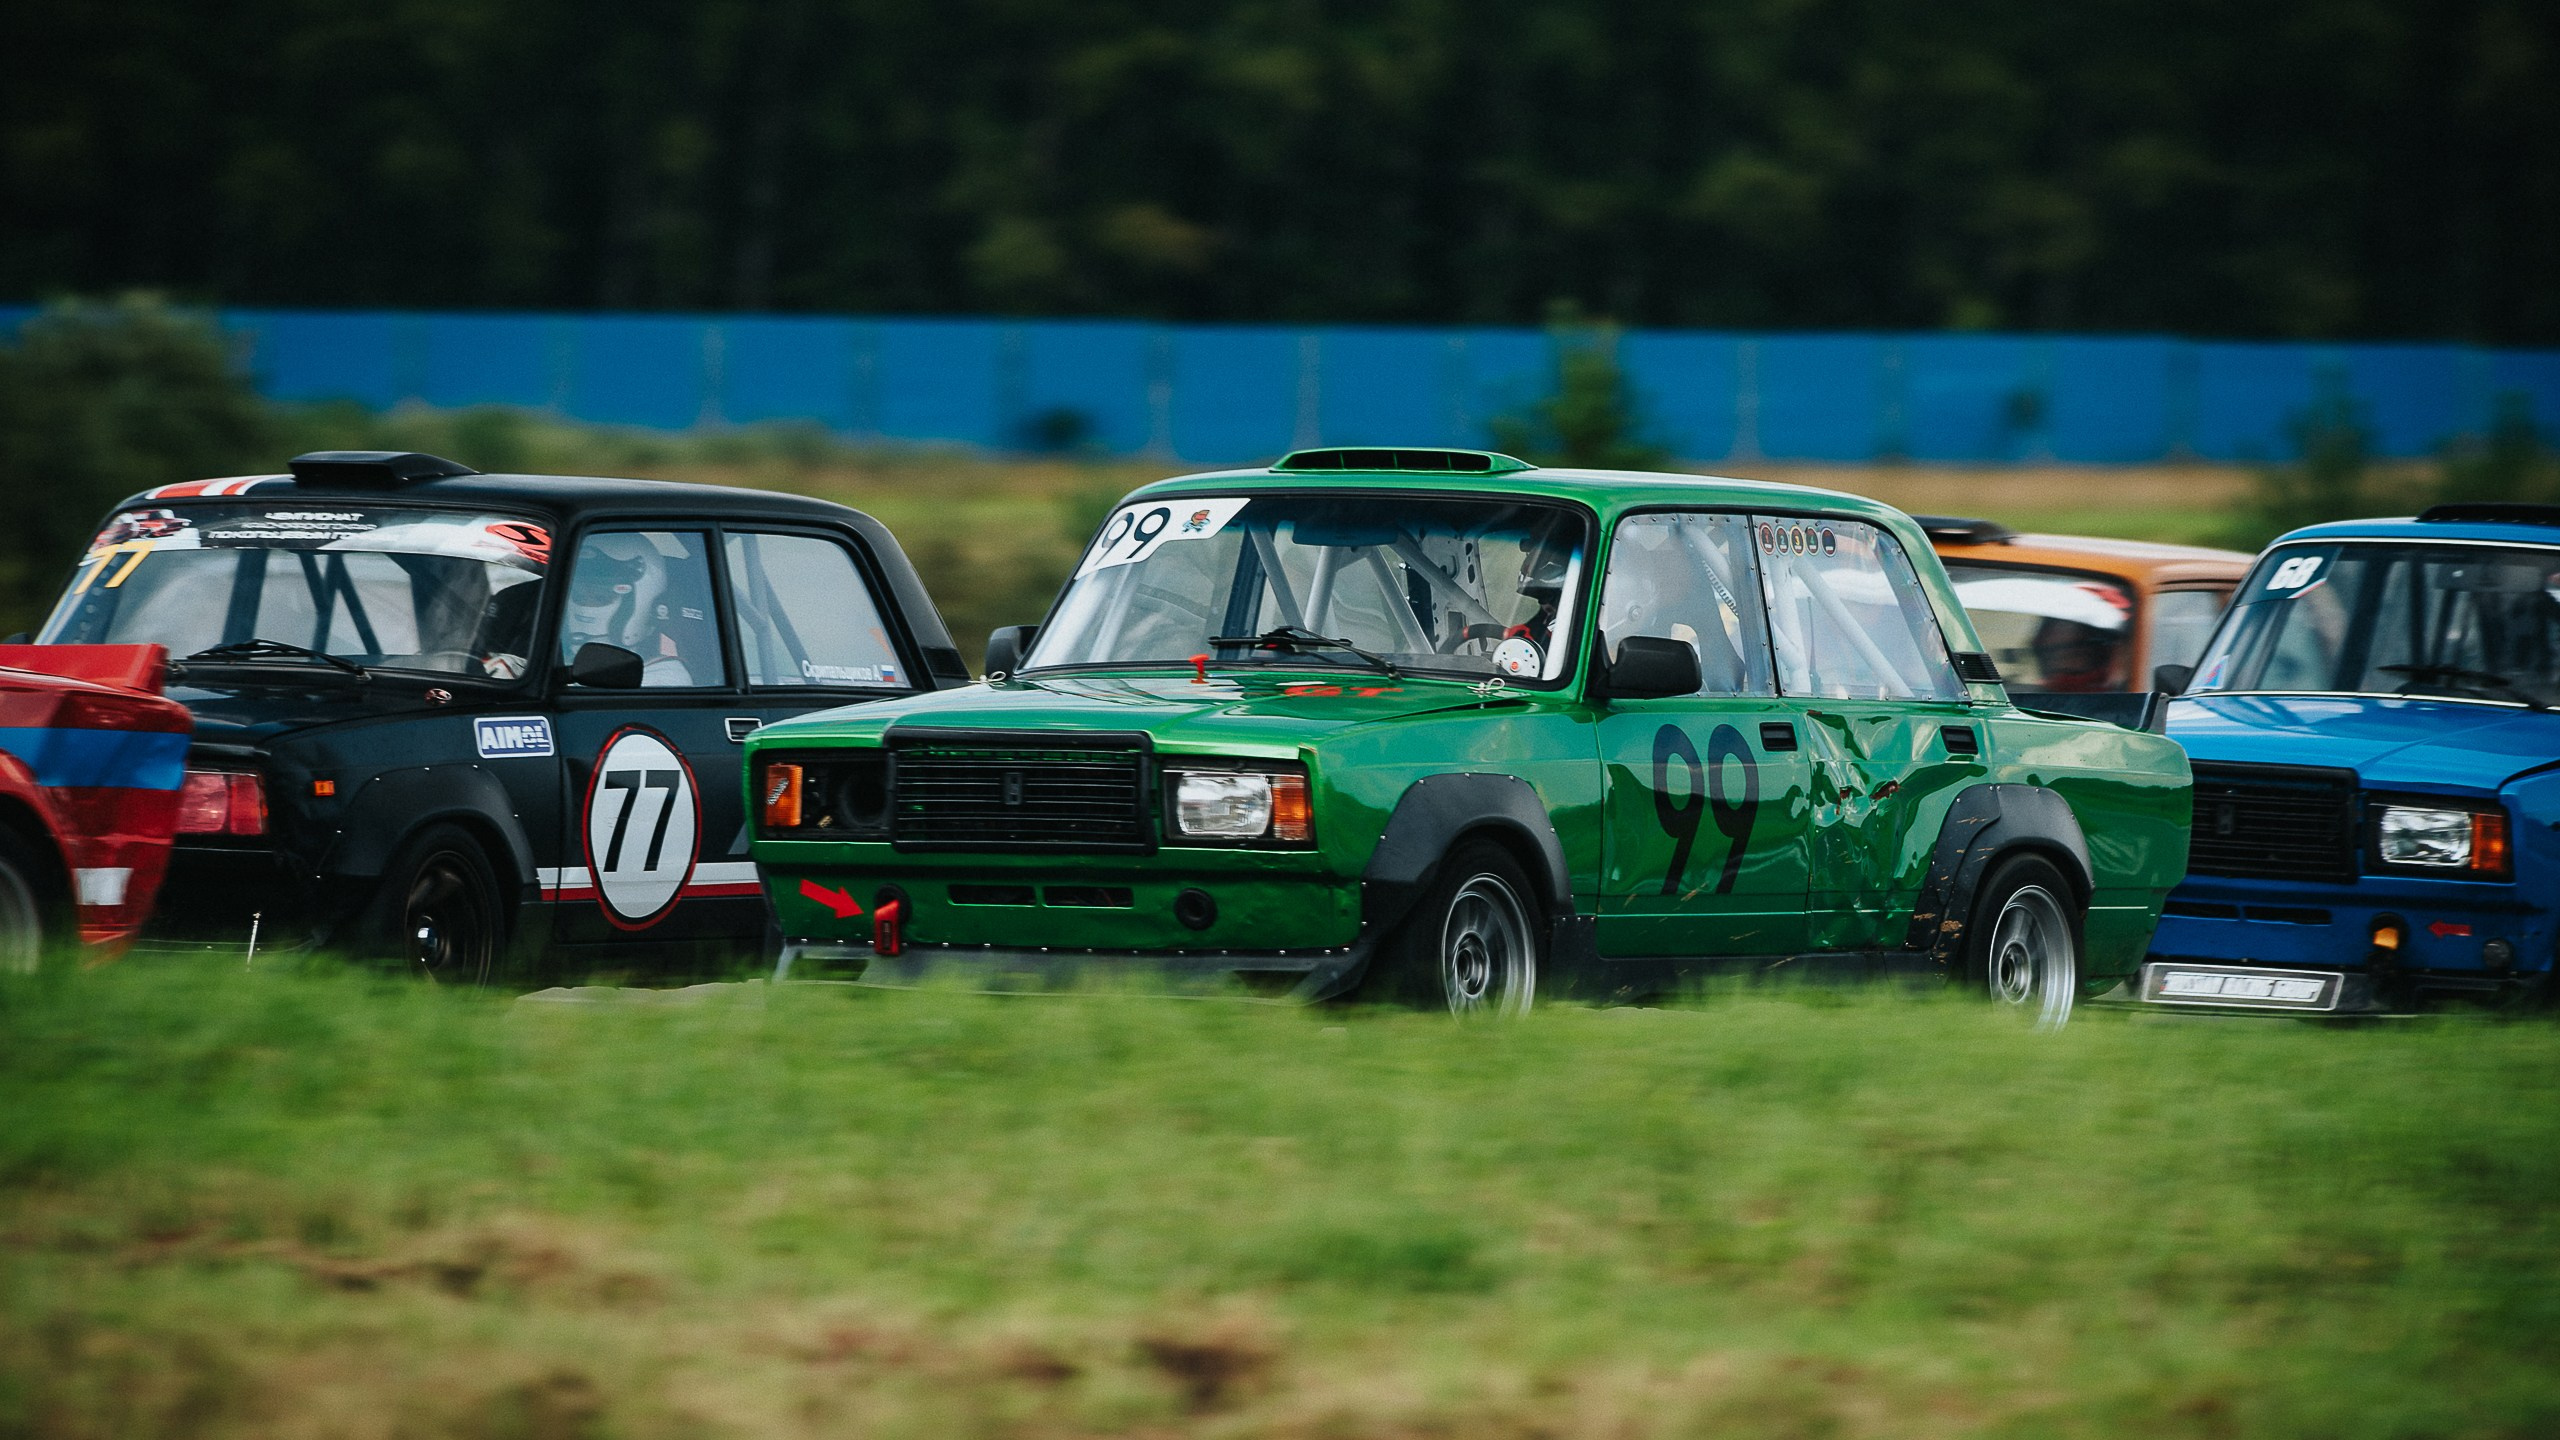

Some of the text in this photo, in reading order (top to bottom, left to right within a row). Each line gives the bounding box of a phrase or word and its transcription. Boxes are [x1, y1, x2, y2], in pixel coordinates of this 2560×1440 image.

[1094, 507, 1171, 567] 99
[73, 540, 157, 595] 77
[2266, 556, 2324, 590] 68
[1284, 685, 1404, 698] GT
[481, 725, 550, 749] AIMOL
[603, 769, 680, 873] 77
[1652, 723, 1760, 896] 99
